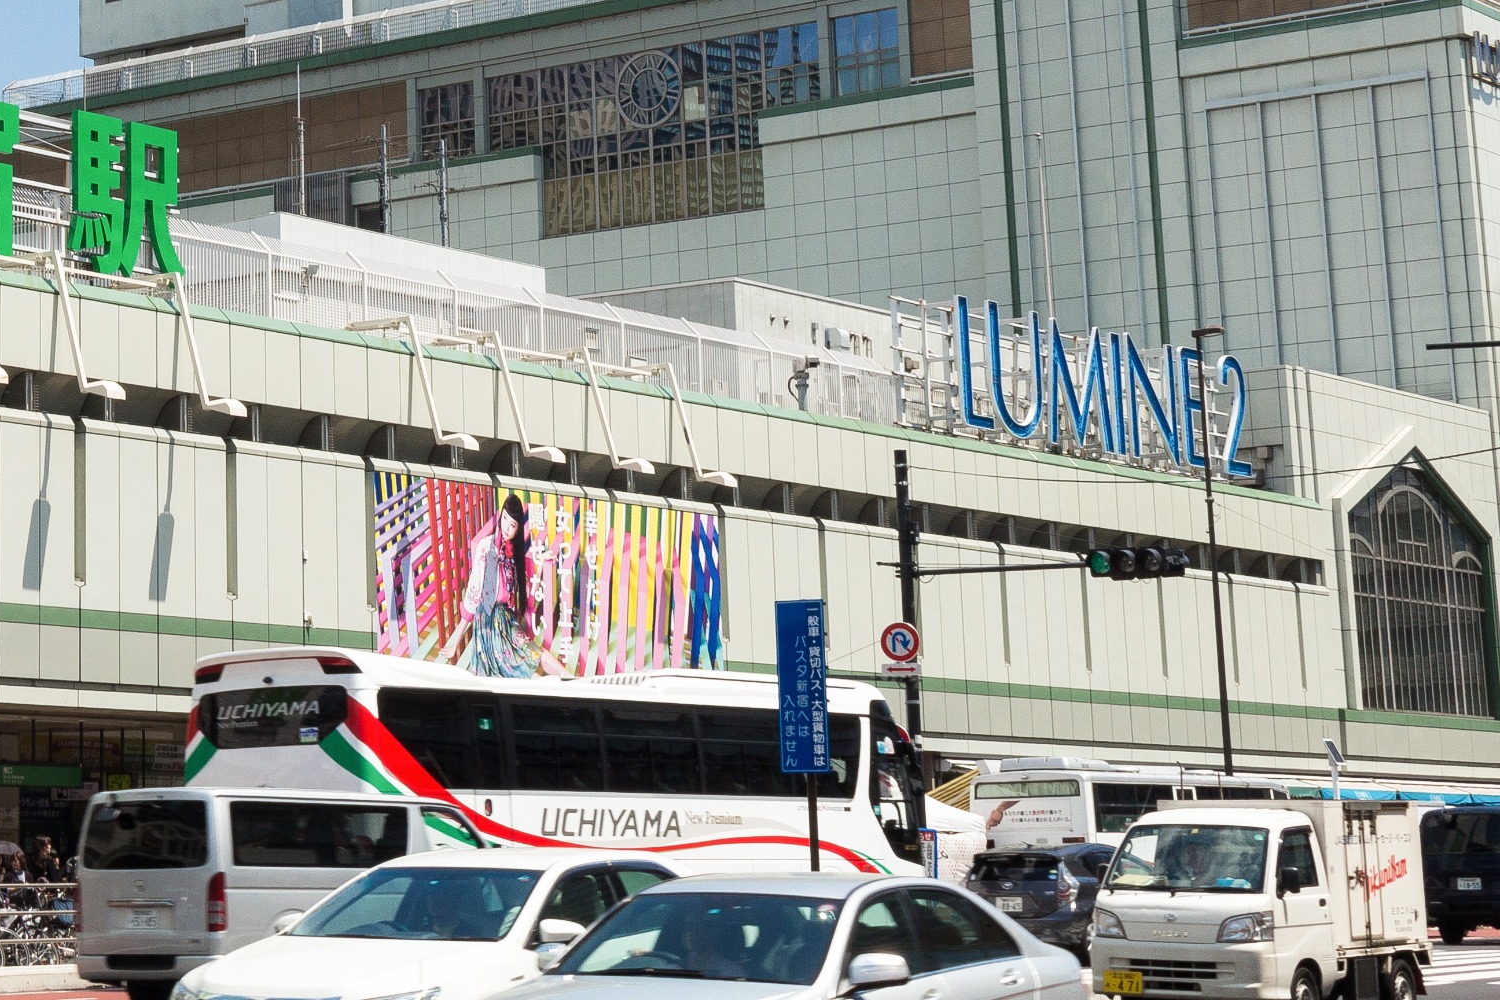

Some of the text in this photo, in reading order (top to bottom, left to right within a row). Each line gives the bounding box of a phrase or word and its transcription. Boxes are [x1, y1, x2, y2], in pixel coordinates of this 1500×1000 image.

[953, 294, 1253, 477] LUMINE 2
[528, 503, 547, 637] 隠せない
[555, 505, 574, 664] 女って上手
[584, 509, 601, 642] 幸せだけ
[217, 700, 320, 720] UCHIYAMA
[783, 694, 798, 767] 入れません
[794, 635, 810, 738] バスタ新宿へは
[806, 607, 826, 767] 一般車・貸切バス・大型貨物車は
[542, 808, 682, 838] UCHIYAMA
[684, 811, 742, 825] New Premium
